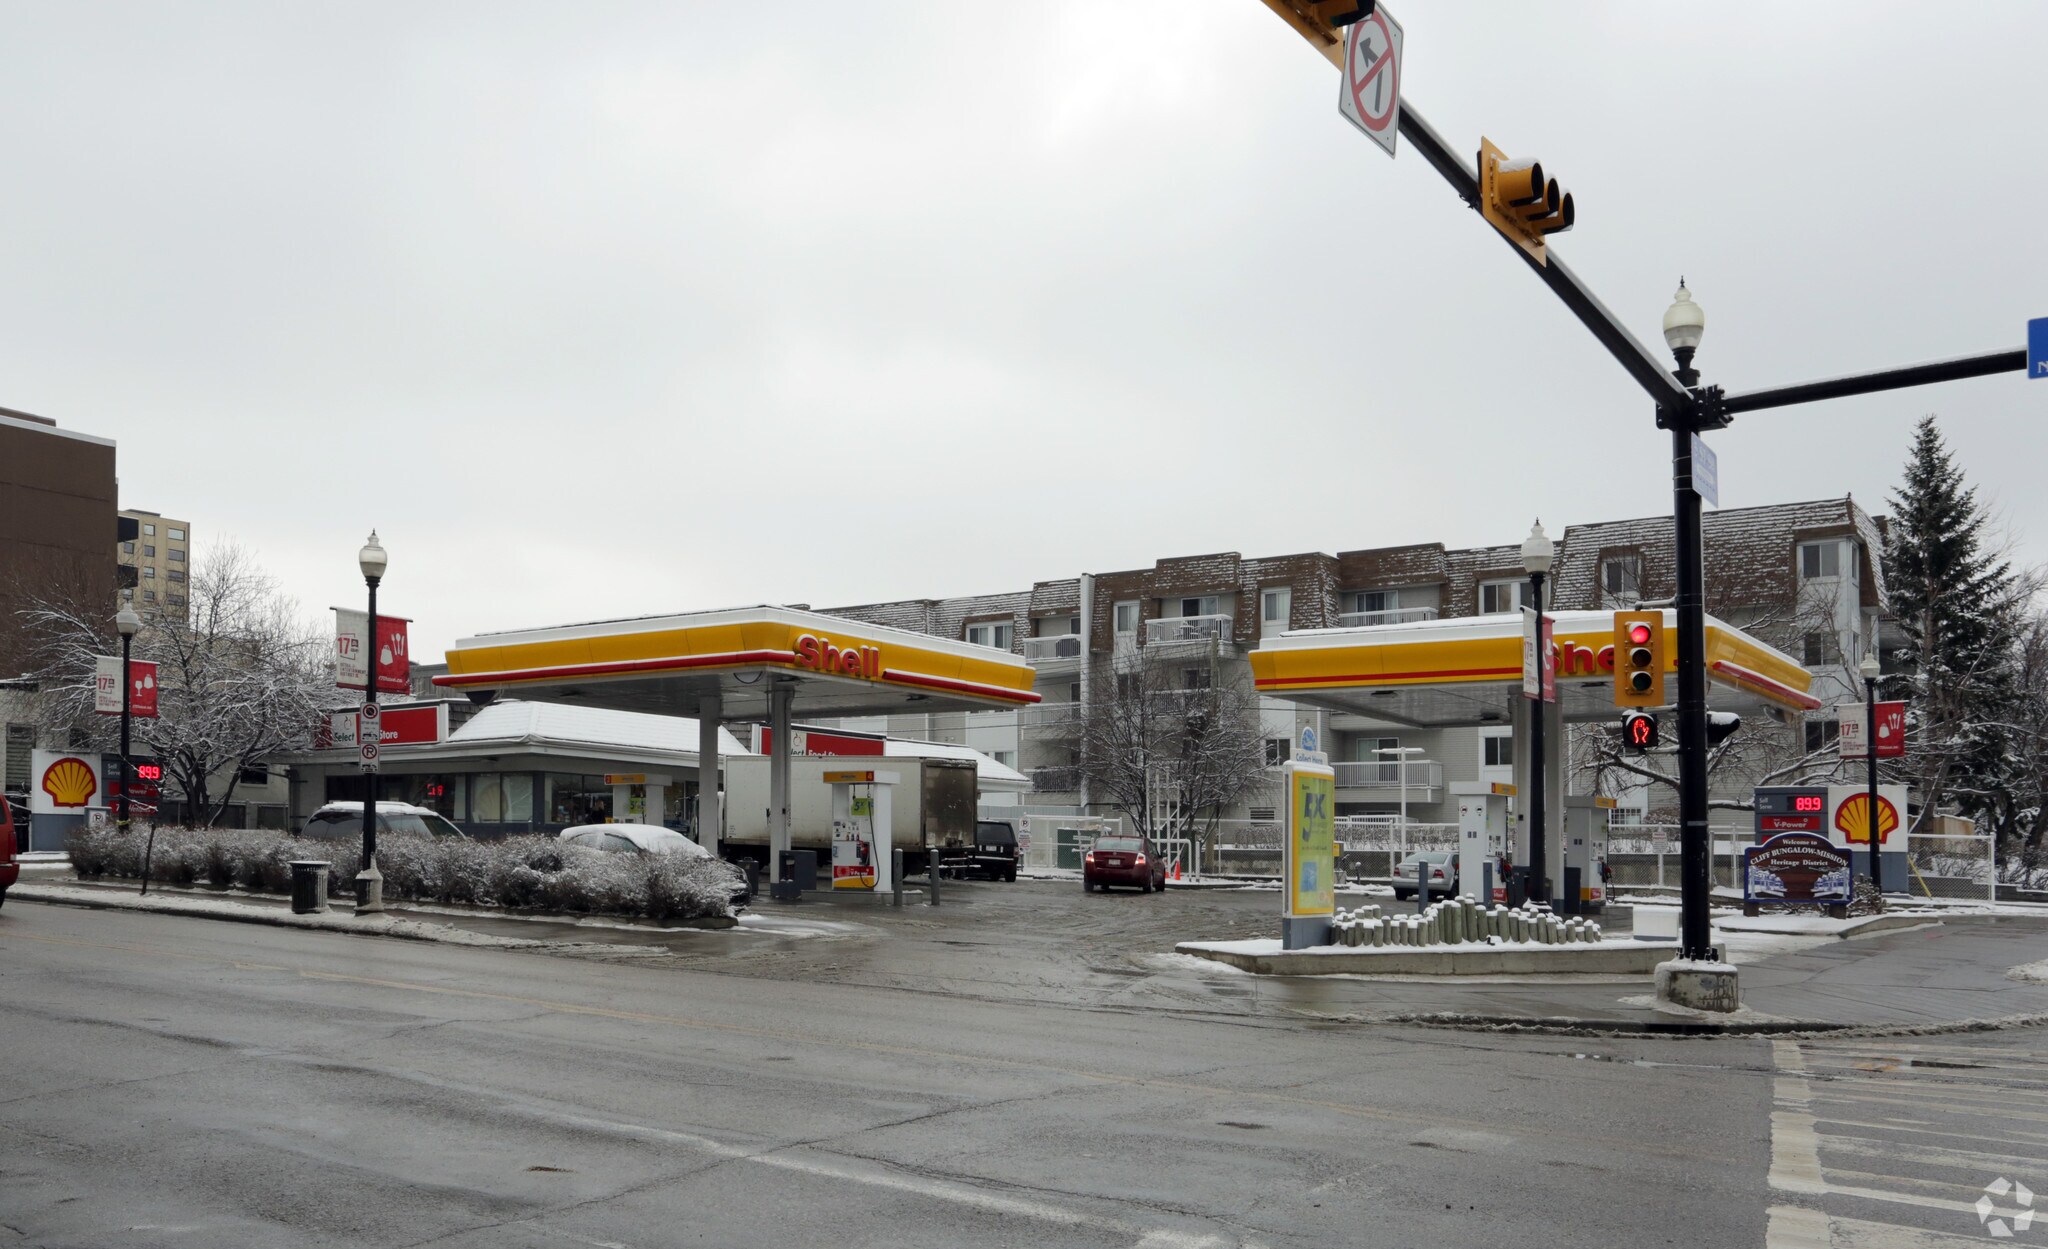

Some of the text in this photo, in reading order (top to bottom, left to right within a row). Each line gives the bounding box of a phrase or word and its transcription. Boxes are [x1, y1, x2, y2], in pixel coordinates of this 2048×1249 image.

[797, 634, 879, 677] Shell
[334, 731, 355, 742] Select
[1750, 847, 1849, 867] CLIFF BUNGALOW-MISSION
[1770, 859, 1800, 867] Heritage
